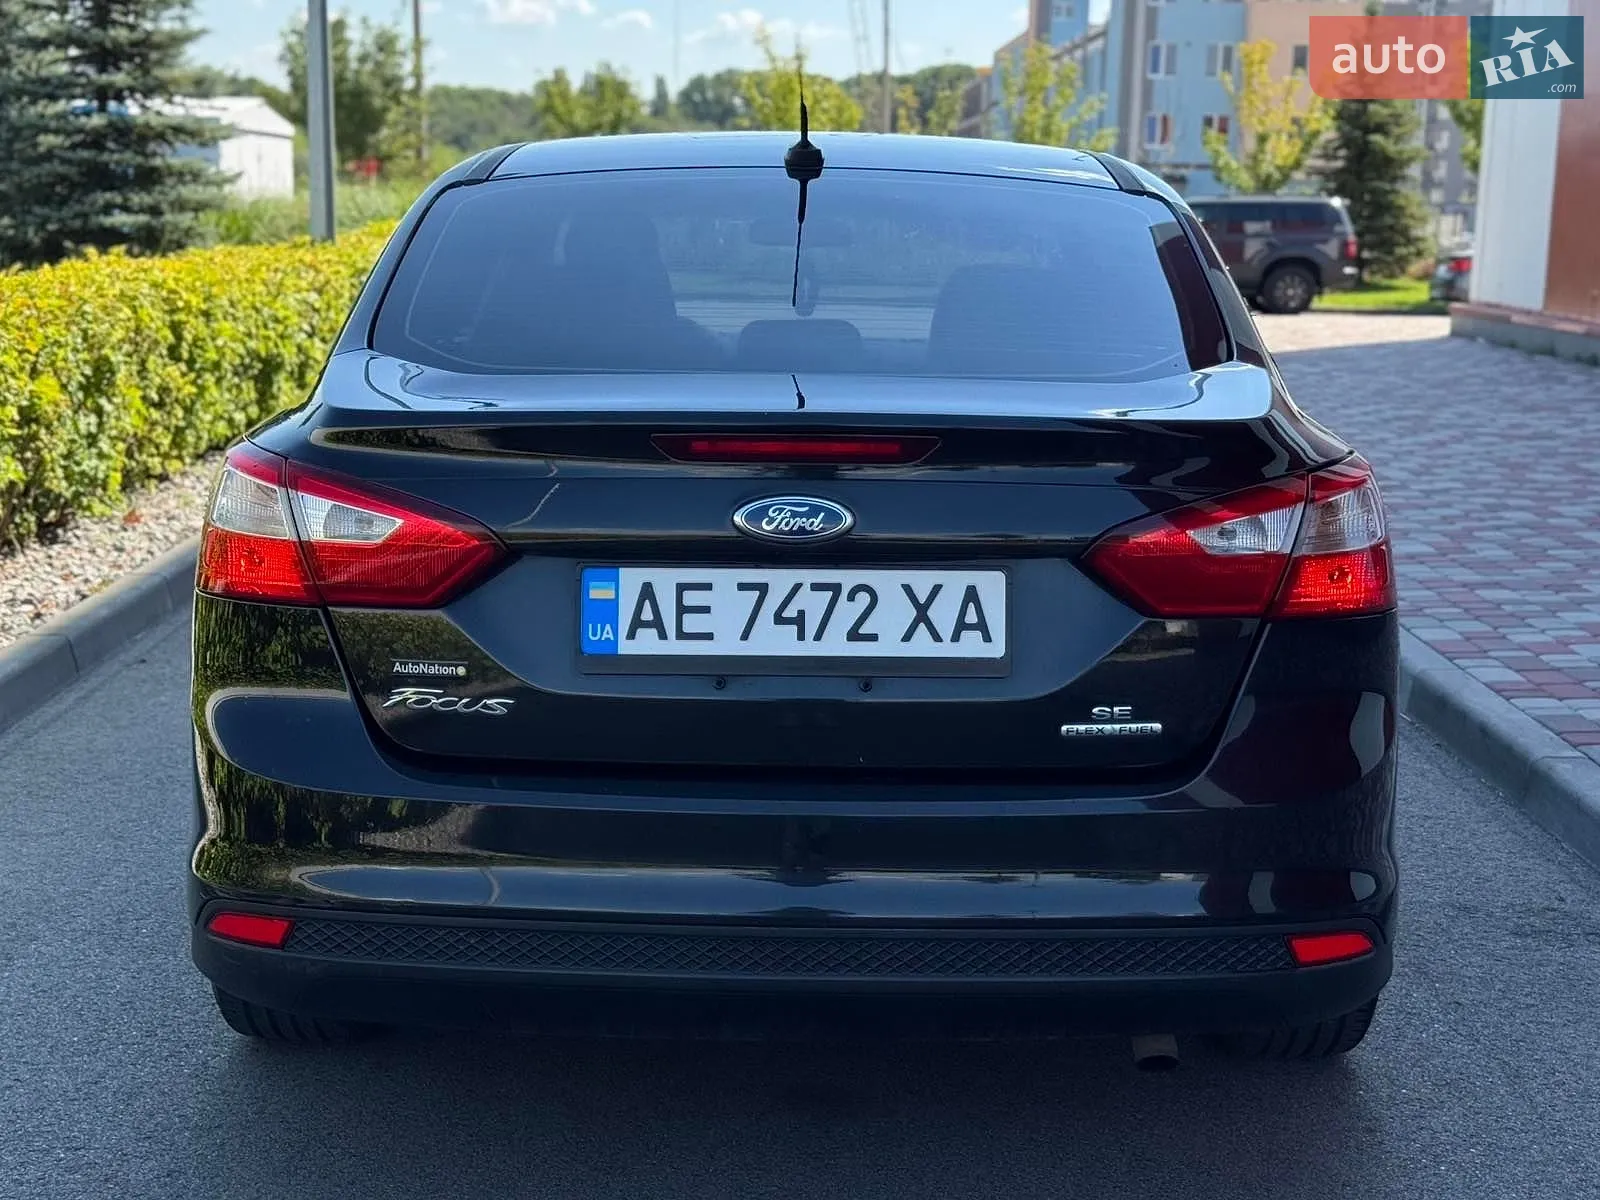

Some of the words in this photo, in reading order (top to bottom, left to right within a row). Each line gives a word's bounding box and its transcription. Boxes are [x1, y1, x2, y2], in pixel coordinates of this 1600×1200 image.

[761, 504, 824, 532] Ford
[625, 581, 715, 641] AE
[736, 582, 879, 642] 7472
[900, 583, 993, 643] XA
[588, 624, 614, 641] UA
[393, 662, 457, 676] AutoNation
[1091, 706, 1132, 720] SE
[1065, 726, 1105, 735] FLEX
[1118, 725, 1159, 735] FUEL
